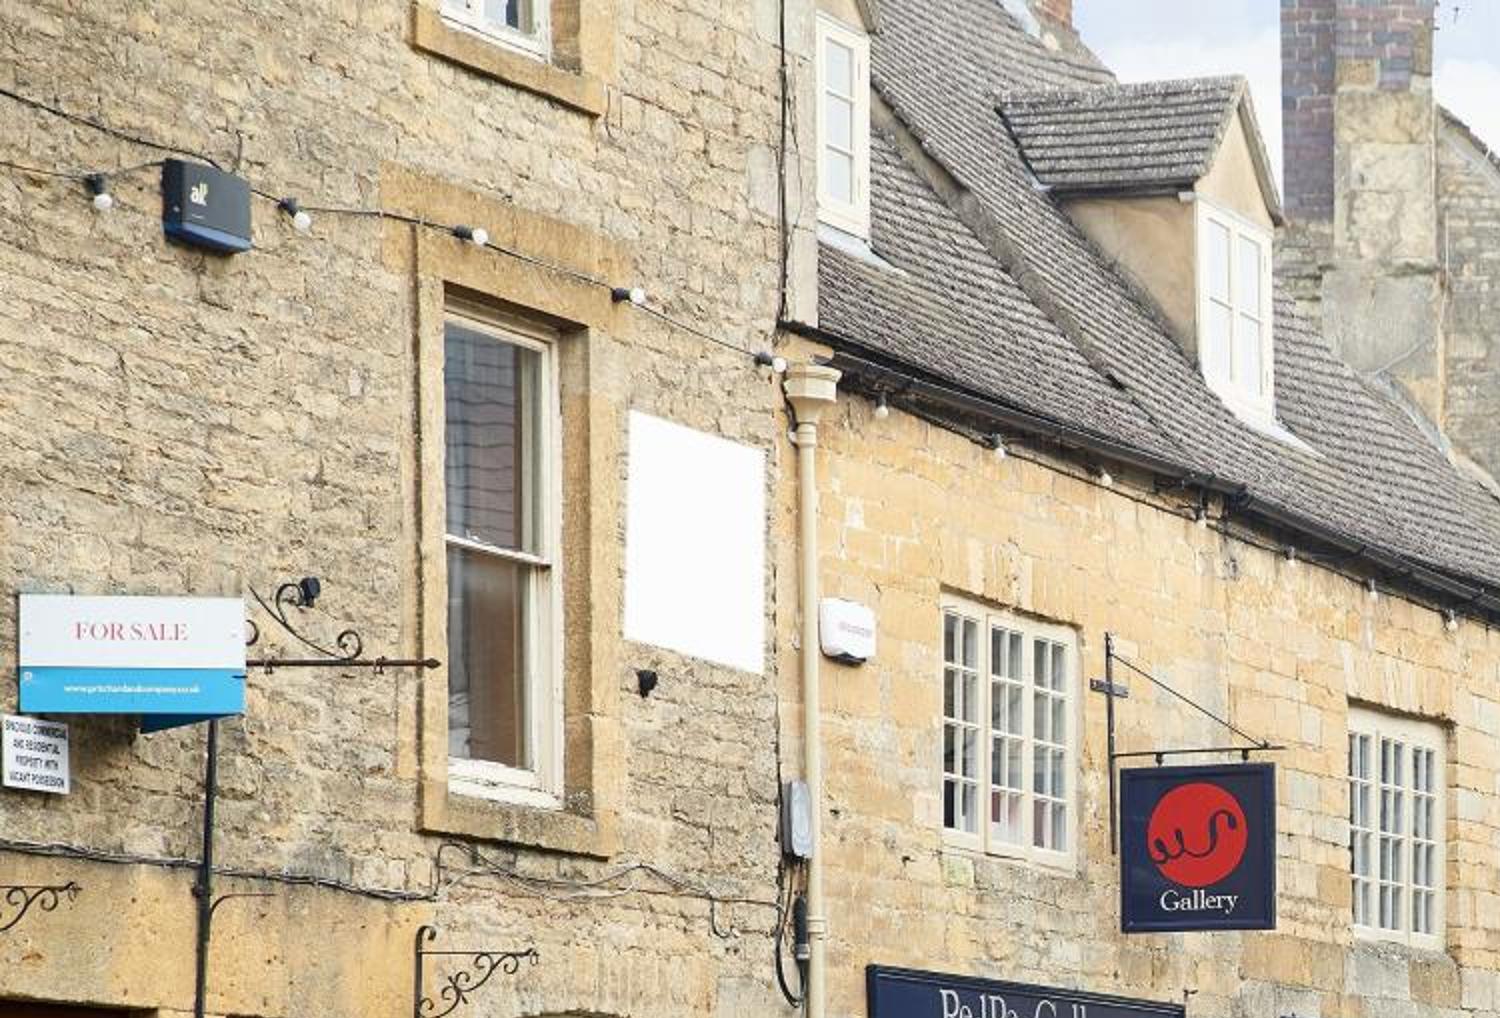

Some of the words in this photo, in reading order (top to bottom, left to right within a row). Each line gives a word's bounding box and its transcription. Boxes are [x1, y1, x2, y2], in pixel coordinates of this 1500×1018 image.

[75, 621, 126, 642] FOR
[129, 622, 189, 642] SALE
[1159, 888, 1239, 915] Gallery
